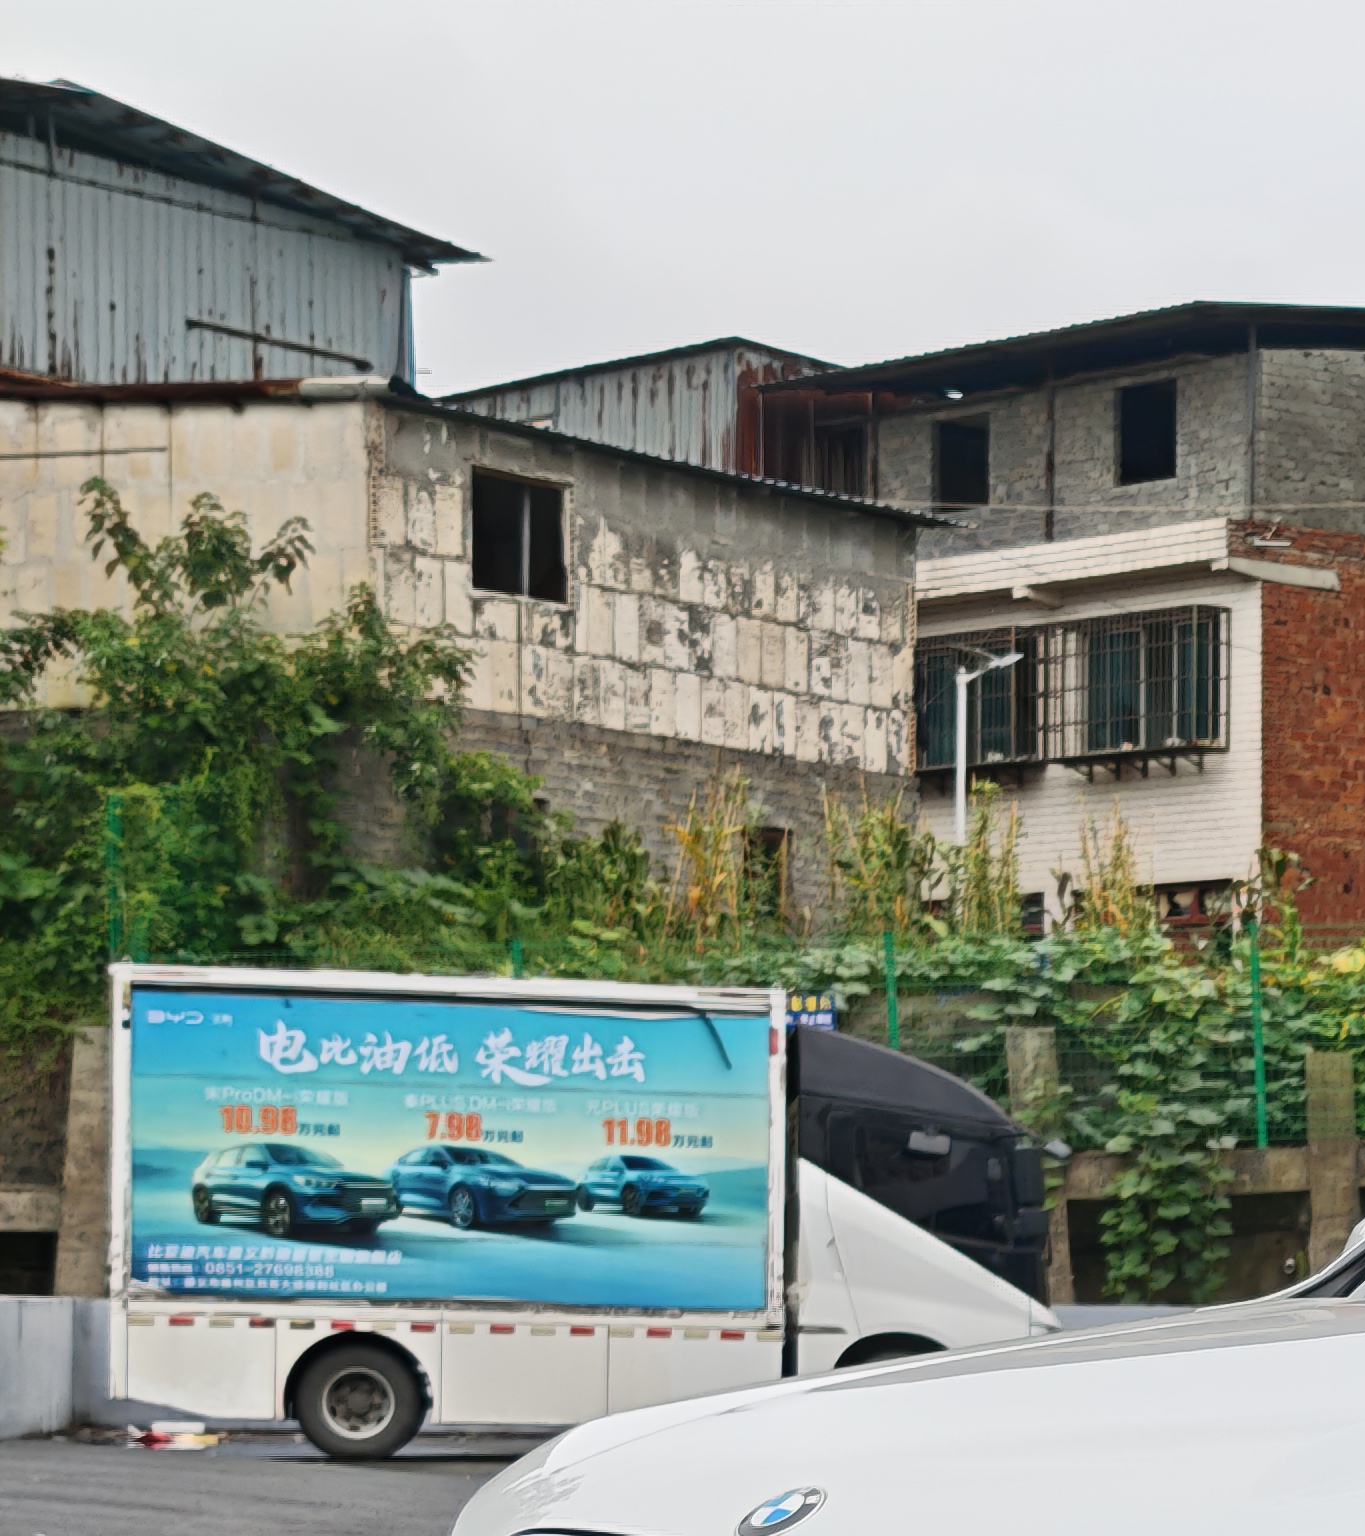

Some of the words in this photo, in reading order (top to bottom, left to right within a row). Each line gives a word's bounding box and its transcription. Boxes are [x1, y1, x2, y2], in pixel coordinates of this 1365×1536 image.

[257, 1018, 459, 1074] 电比油低
[474, 1026, 646, 1087] 荣耀出击
[219, 1104, 298, 1136] 10.98
[424, 1111, 483, 1142] 7.98
[601, 1116, 671, 1147] 11.98
